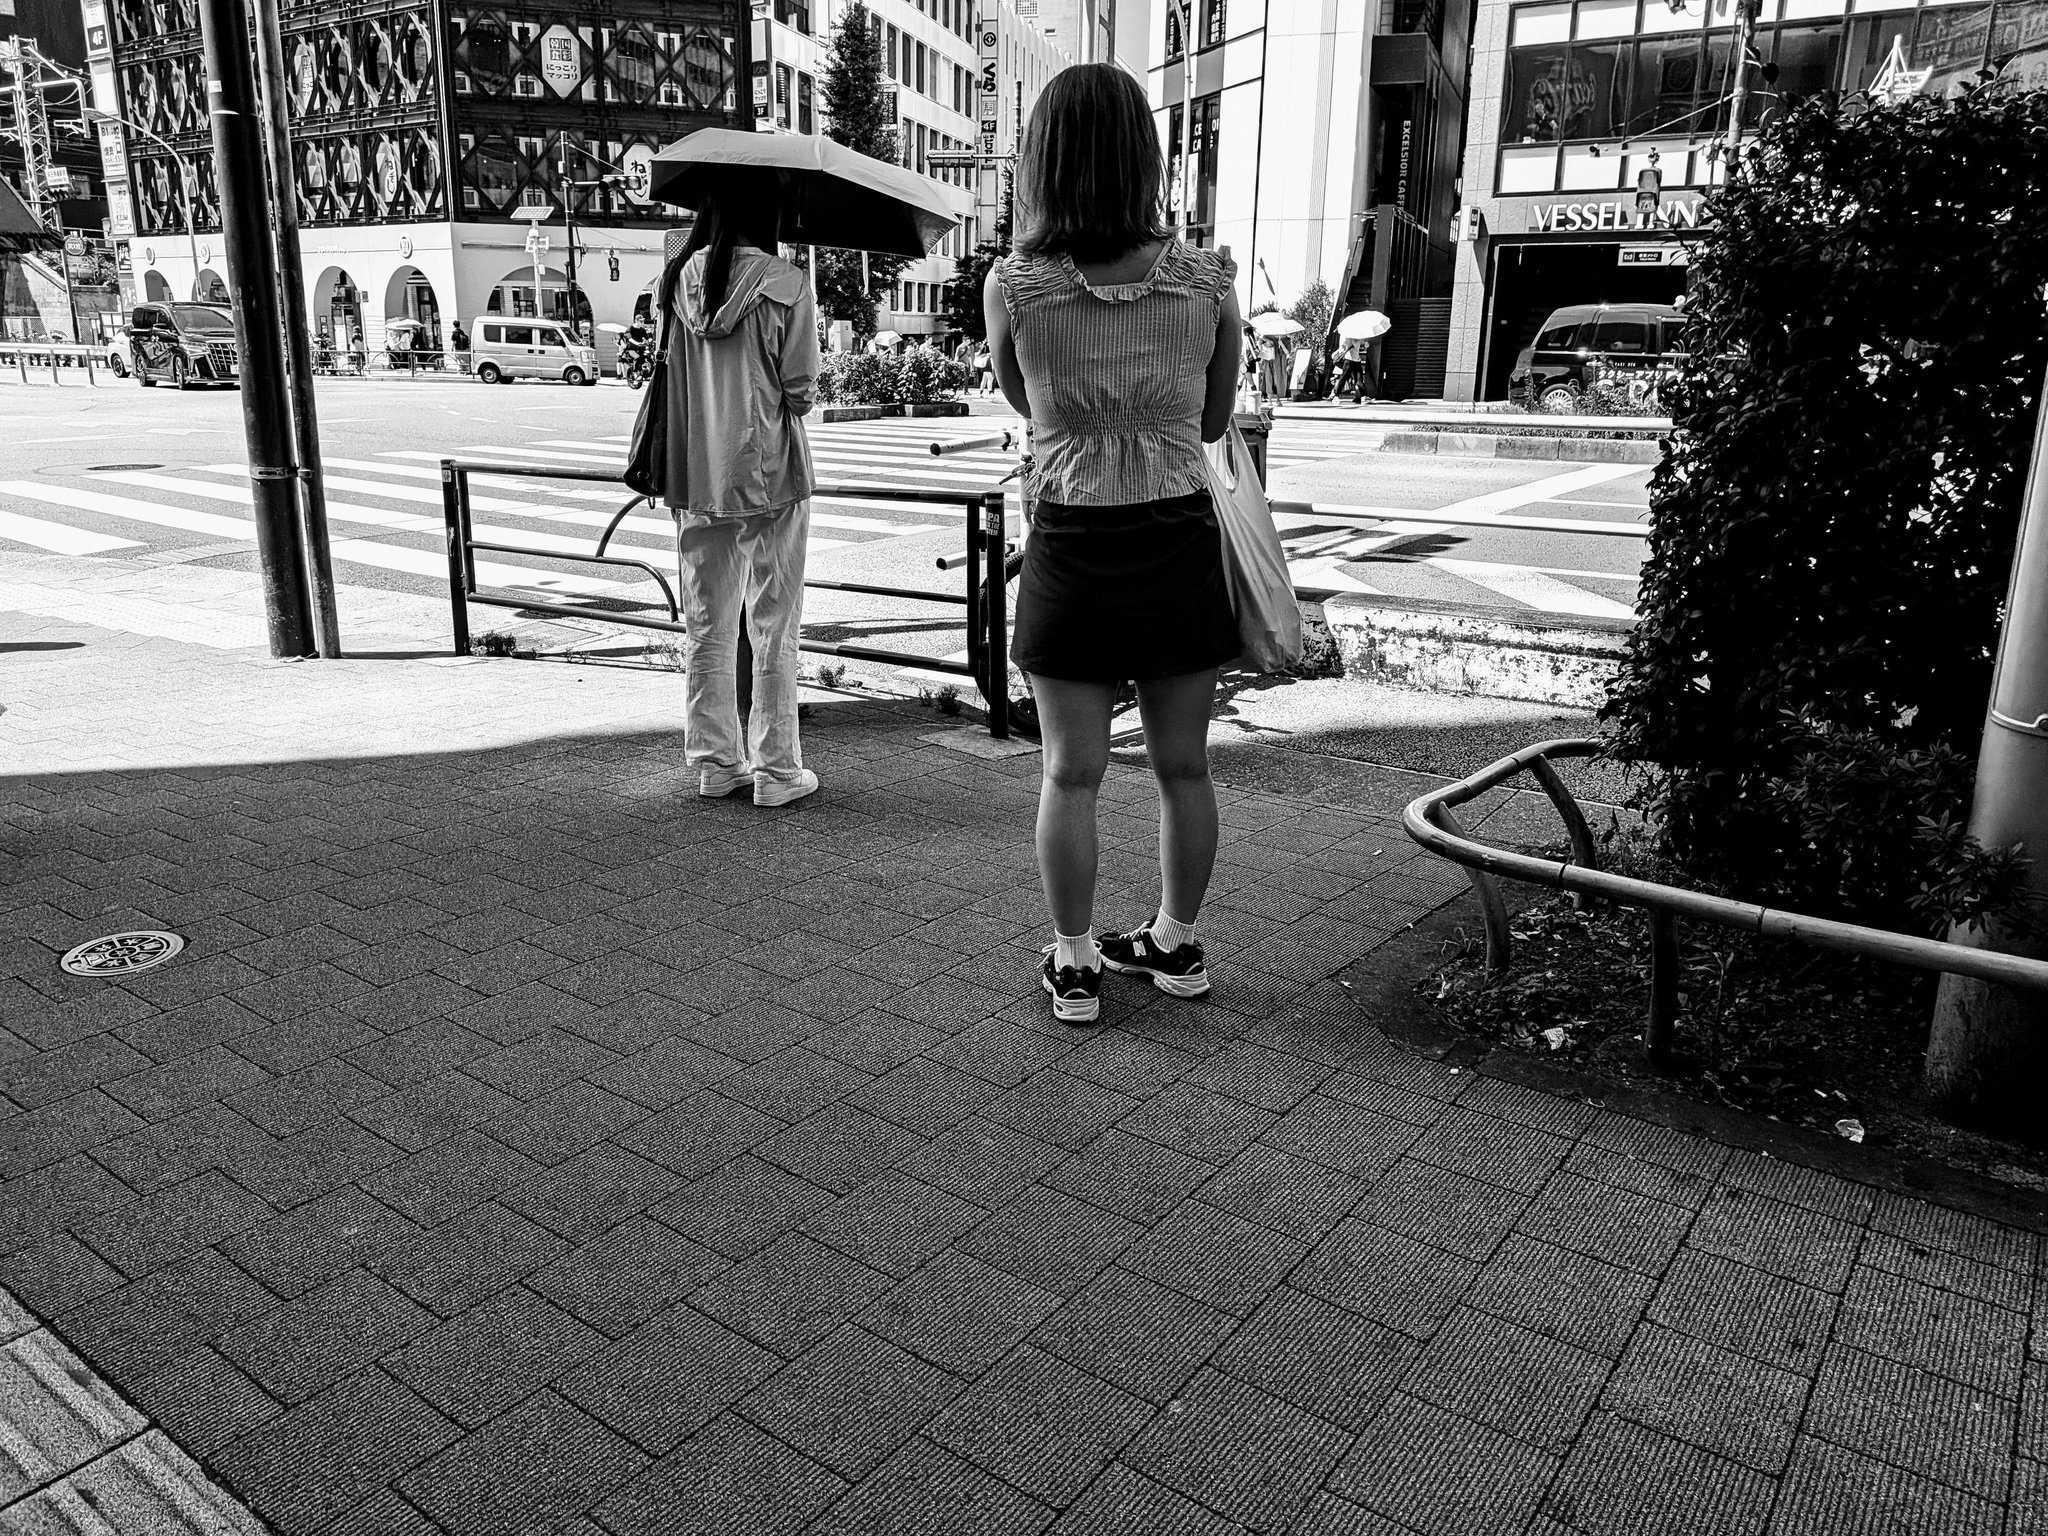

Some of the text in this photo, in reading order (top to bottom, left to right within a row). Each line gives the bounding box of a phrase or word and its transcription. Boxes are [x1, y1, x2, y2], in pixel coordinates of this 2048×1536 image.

[93, 30, 104, 45] 4F
[546, 63, 577, 72] にっこり
[546, 72, 577, 80] マッコリ
[983, 122, 995, 131] 4F
[1400, 119, 1411, 177] EXCELSIOR
[1533, 201, 1629, 232] VESSEL
[1132, 941, 1147, 957] N
